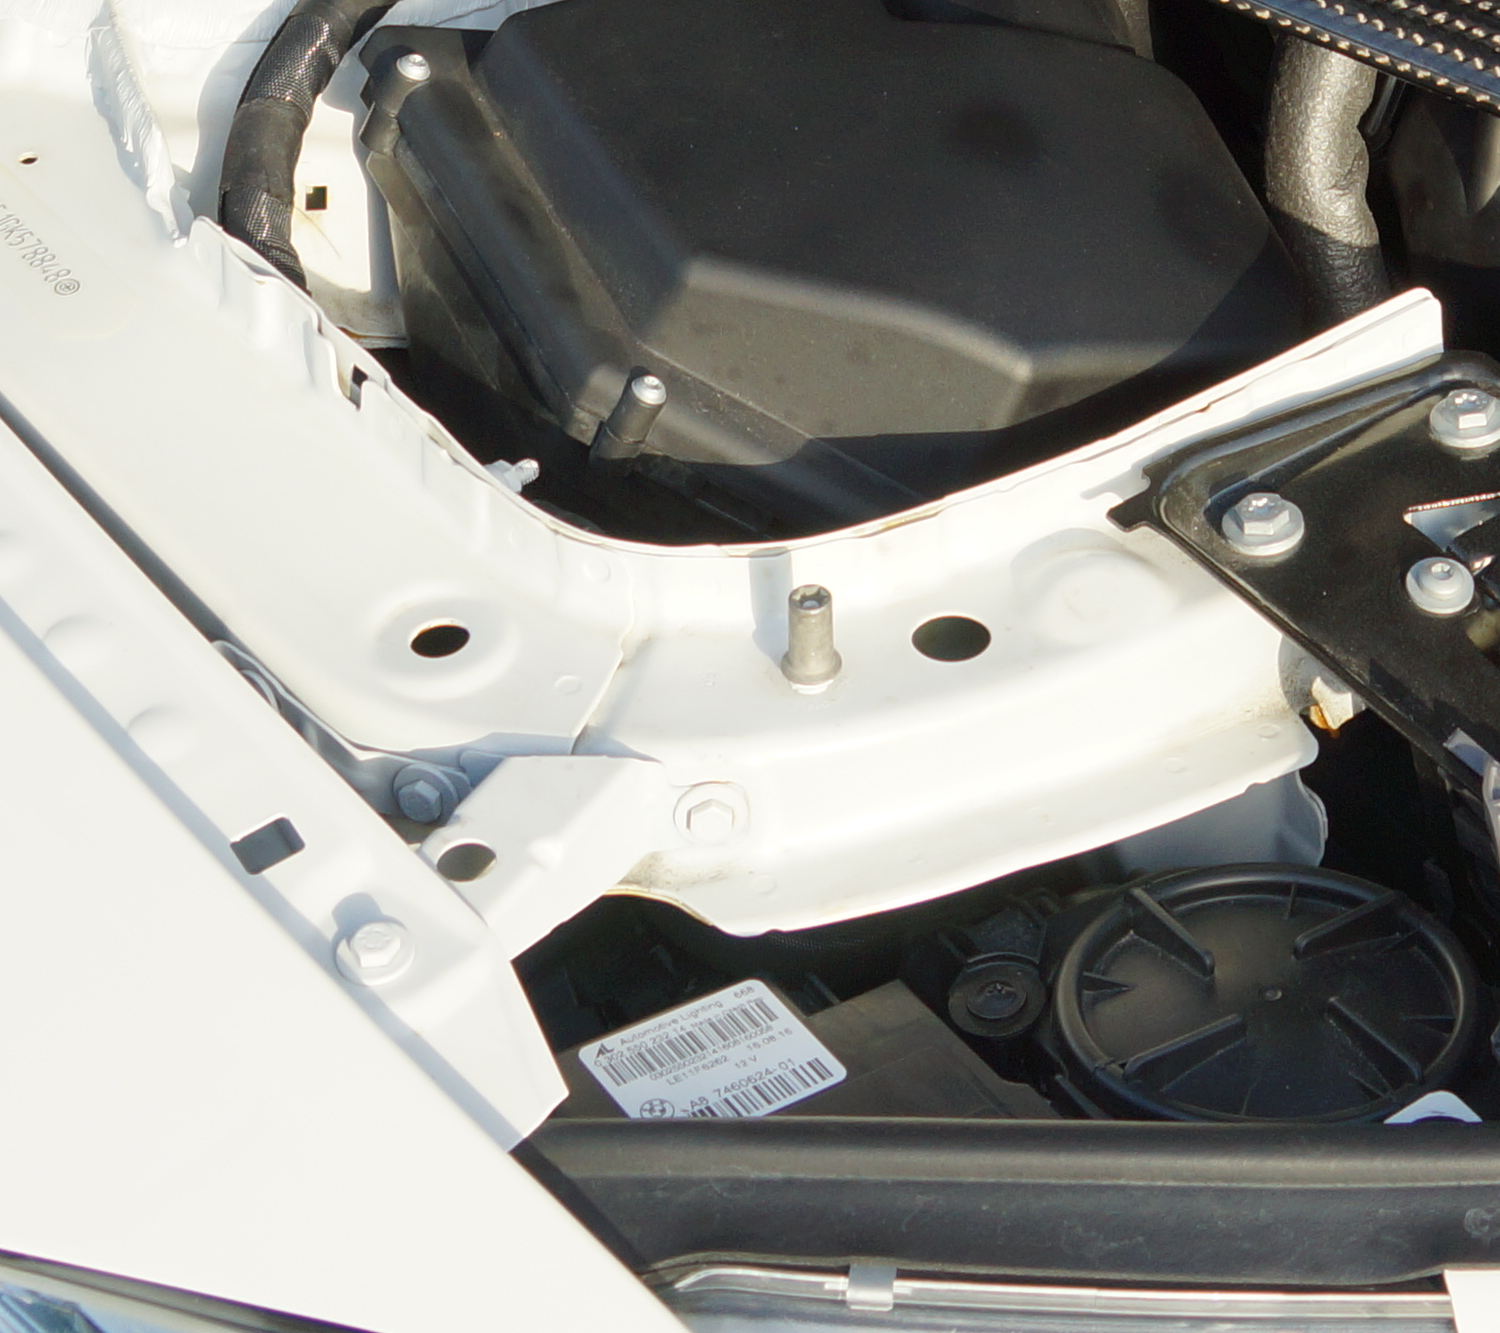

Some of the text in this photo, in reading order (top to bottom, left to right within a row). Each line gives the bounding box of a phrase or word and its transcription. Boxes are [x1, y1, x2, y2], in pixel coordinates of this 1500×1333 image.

[620, 1018, 679, 1046] Automotive
[680, 1001, 723, 1021] Lighting
[690, 1058, 796, 1110] A8 7460624-01
[734, 1055, 758, 1069] 12 V
